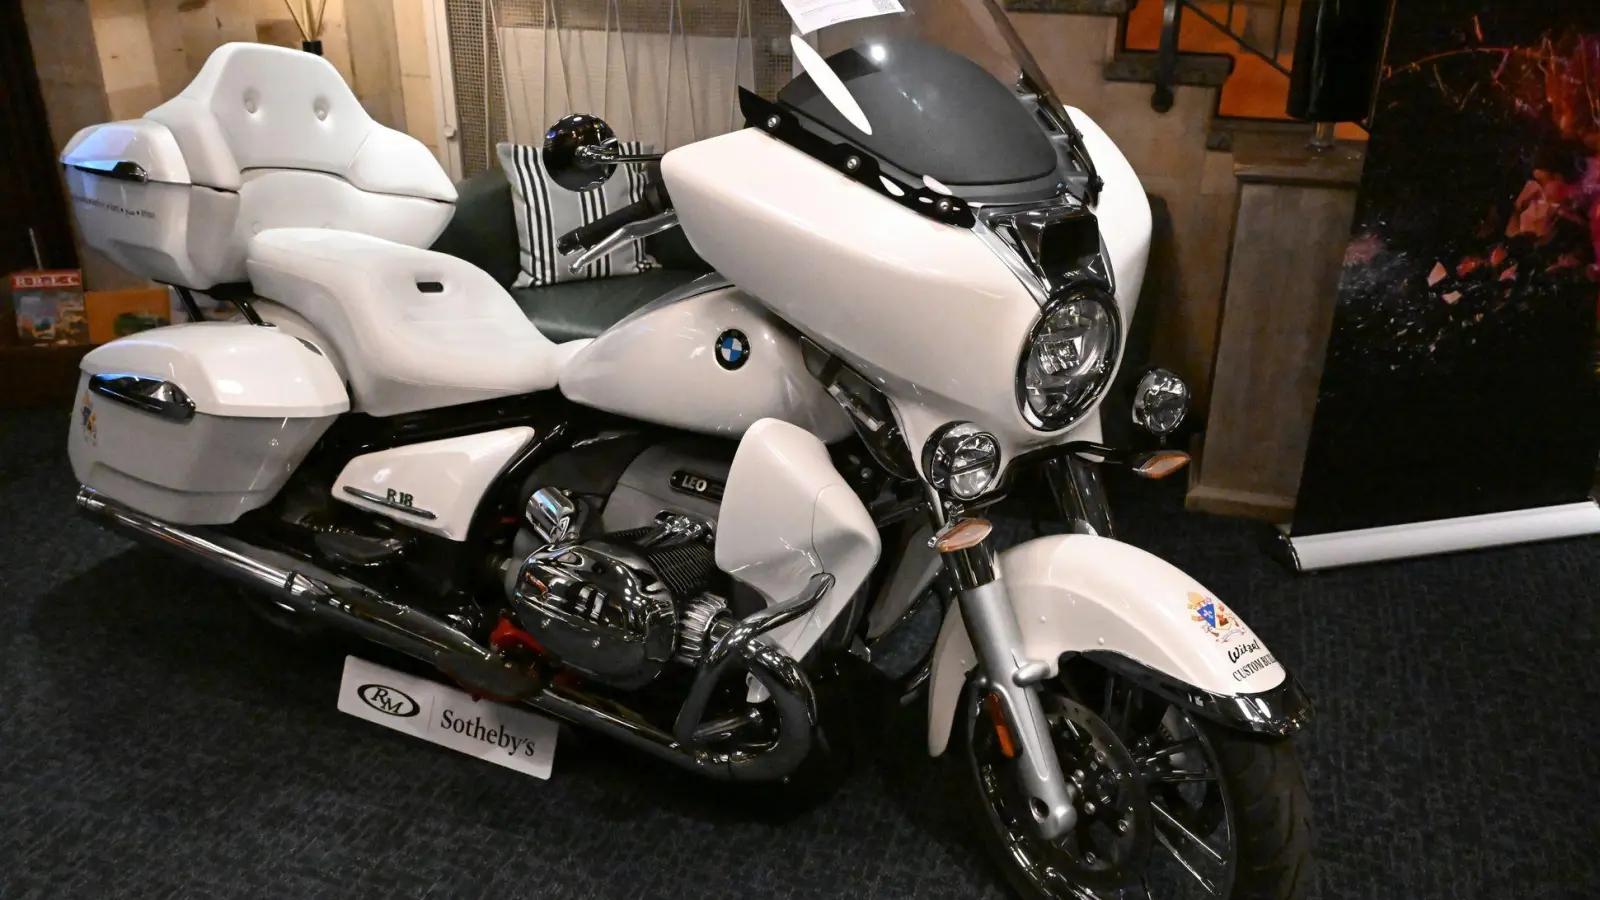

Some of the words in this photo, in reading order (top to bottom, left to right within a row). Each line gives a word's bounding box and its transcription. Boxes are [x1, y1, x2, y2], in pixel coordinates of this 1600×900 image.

[681, 475, 708, 492] LEO
[1232, 658, 1265, 682] CUSTOM
[370, 686, 403, 714] RM
[440, 709, 536, 757] Sotheby's
